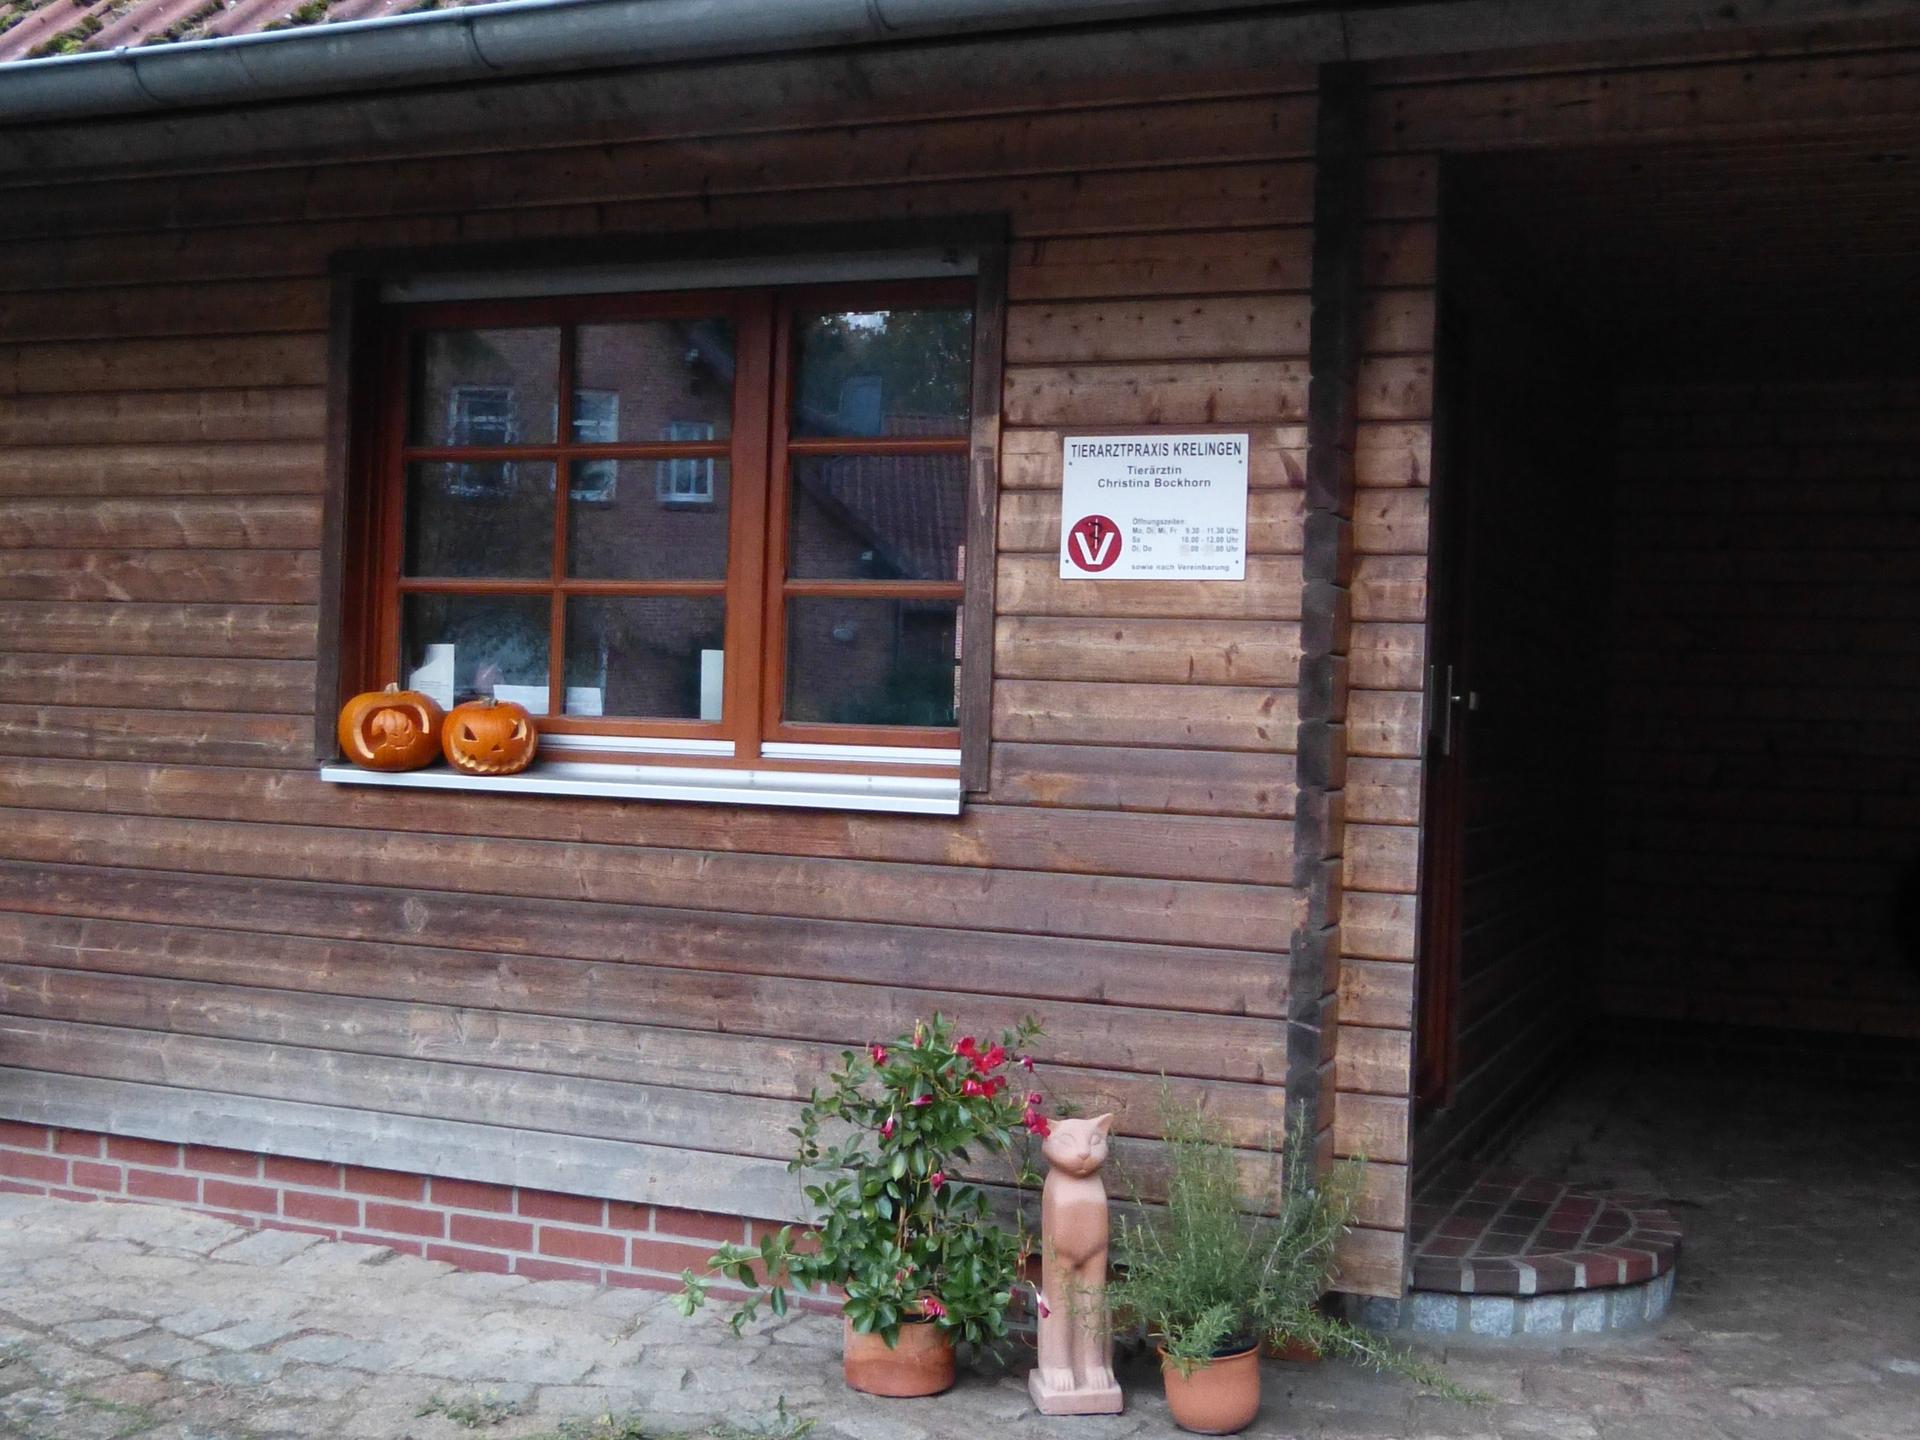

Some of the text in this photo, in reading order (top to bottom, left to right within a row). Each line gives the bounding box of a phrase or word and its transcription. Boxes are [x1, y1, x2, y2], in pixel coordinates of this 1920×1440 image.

[1071, 441, 1242, 458] TIERARZTPRAXIS KRELINGEN
[1127, 465, 1182, 475] Tierärztin
[1098, 478, 1211, 488] Christina Bockhorn
[1177, 564, 1230, 572] Vereinbarung
